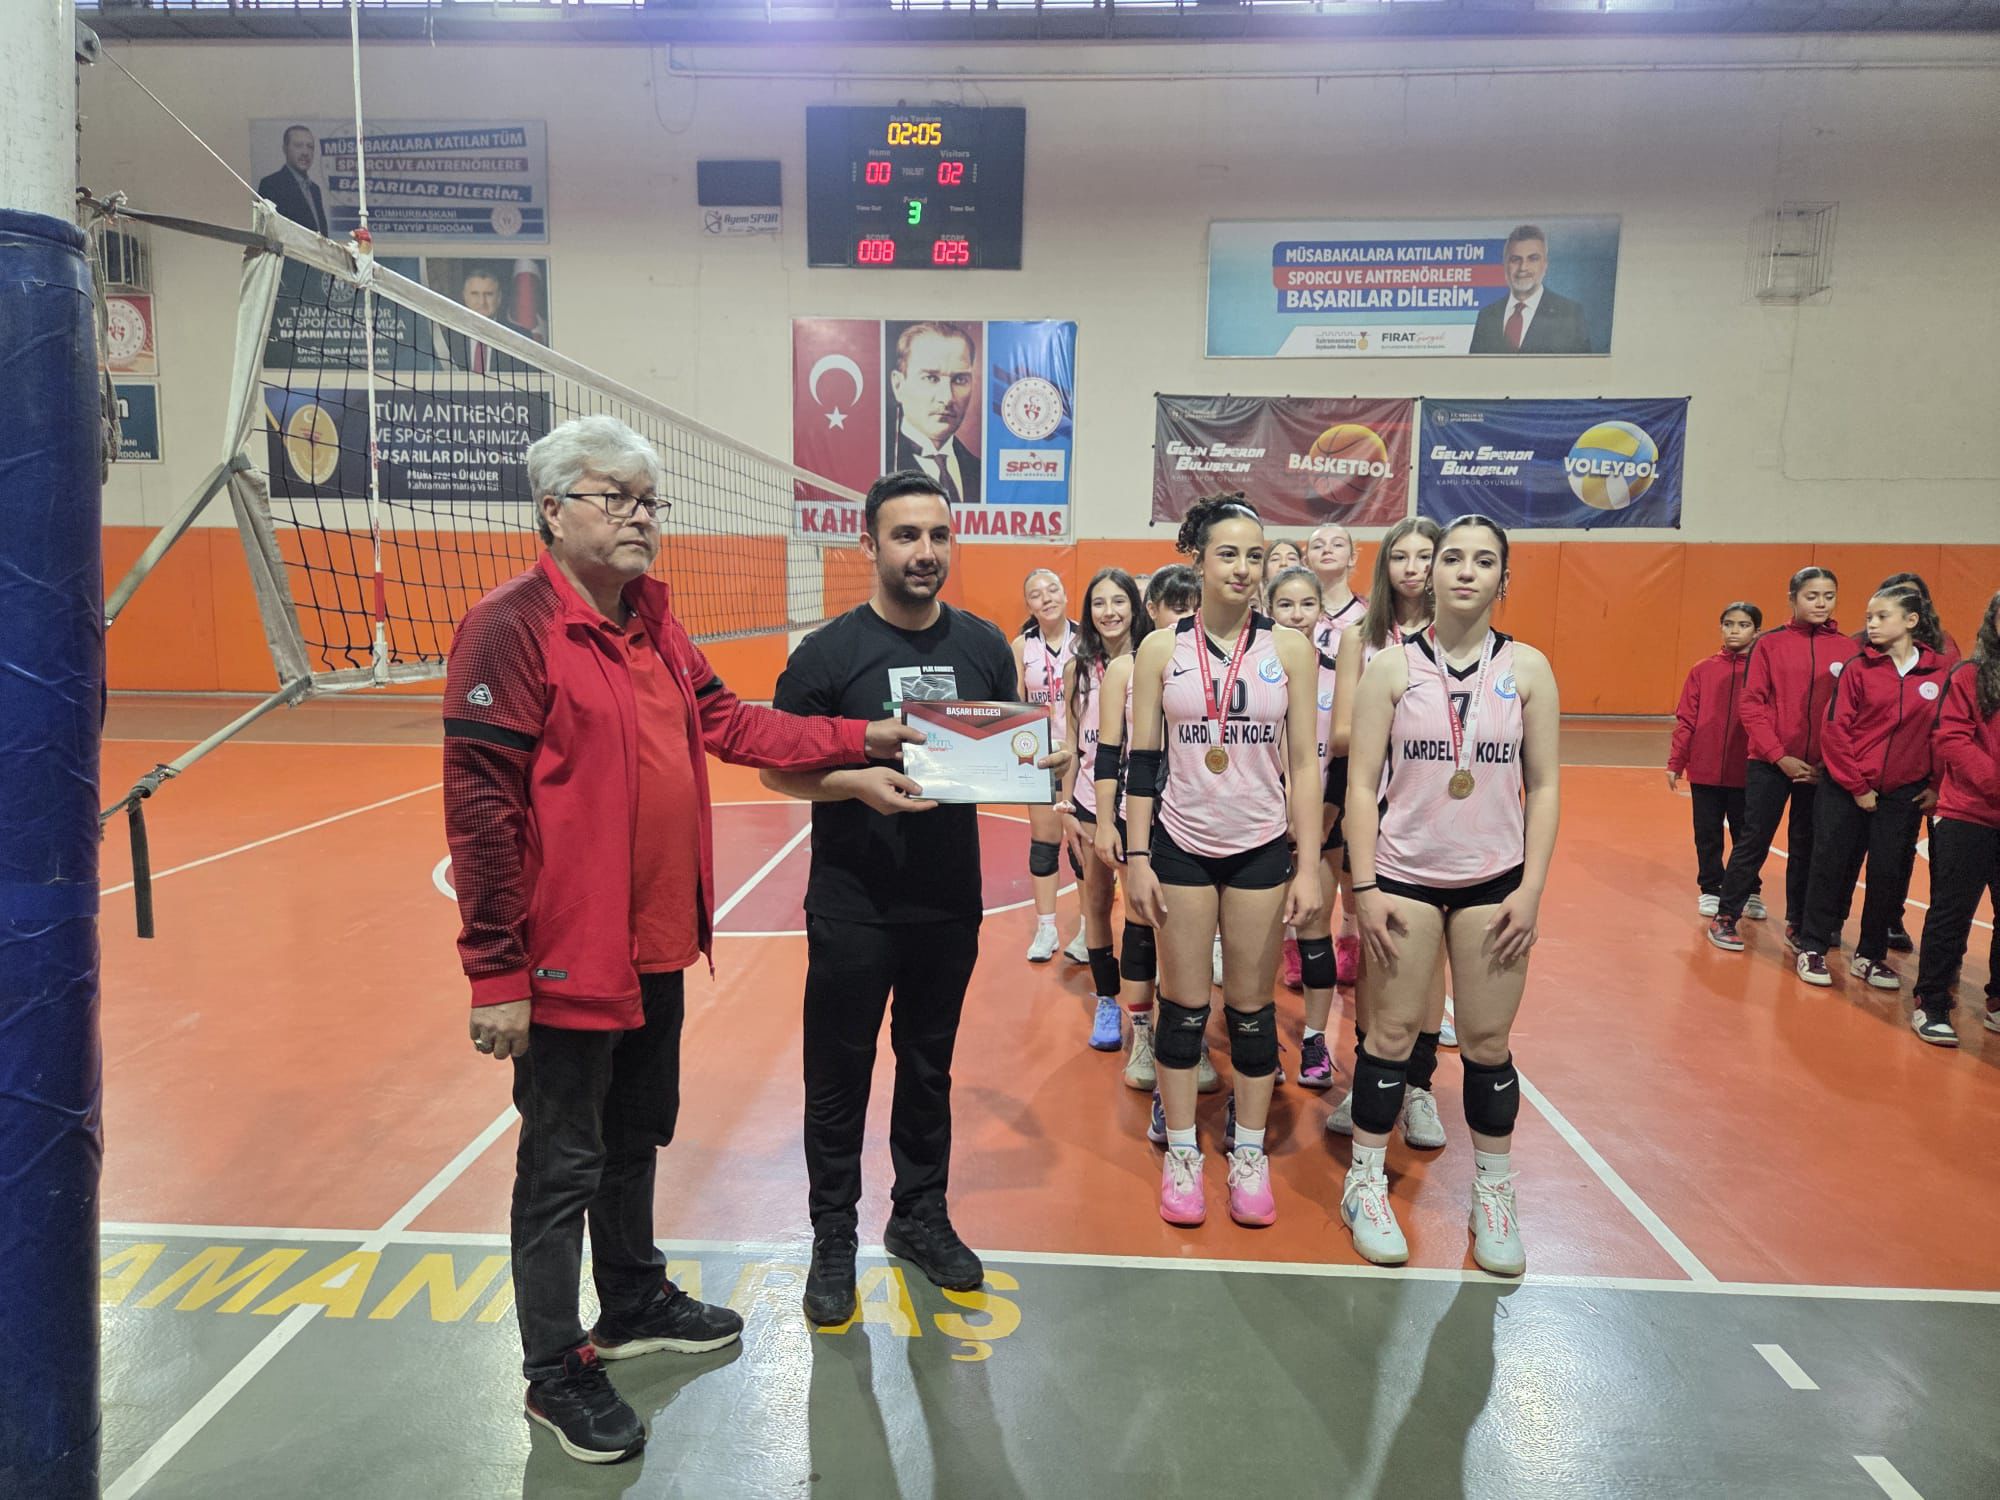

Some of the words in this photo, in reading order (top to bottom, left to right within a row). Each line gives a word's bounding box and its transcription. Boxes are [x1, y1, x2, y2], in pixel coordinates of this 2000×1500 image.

[435, 132, 489, 149] KATILAN
[492, 128, 523, 146] TÜM
[887, 122, 942, 145] 02:05
[338, 159, 393, 171] SPRCU
[396, 158, 416, 171] VE
[415, 156, 522, 171] ANTRENÖRLERE
[865, 162, 892, 184] 00
[937, 162, 965, 184] 02
[443, 183, 524, 201] DİLERİM.
[908, 200, 922, 225] 3
[858, 240, 895, 263] 008
[933, 241, 969, 265] 025
[1286, 246, 1393, 263] MÜSABAKALARA
[1398, 246, 1452, 261] KATILAN
[1456, 244, 1484, 260] TÜM
[1288, 270, 1342, 285] SPORCU
[1345, 270, 1362, 284] VE
[1365, 266, 1472, 284] ANTRENÖRLERE
[1286, 289, 1393, 311] BAŞARILAR
[1397, 285, 1479, 308] DİLERİM.
[277, 319, 293, 329] VE
[1382, 333, 1416, 342] FIRAT
[375, 400, 417, 422] TÜM
[423, 403, 529, 424] ANTRENÖR
[395, 428, 530, 445] SPORCULARIMIZA
[1007, 461, 1057, 473] SPOR
[1289, 454, 1394, 478] BASKETBOL
[1564, 457, 1659, 479] VOLEYBOL
[1317, 628, 1331, 647] 4
[946, 707, 972, 718] BAŞARI
[1448, 691, 1472, 731] 7
